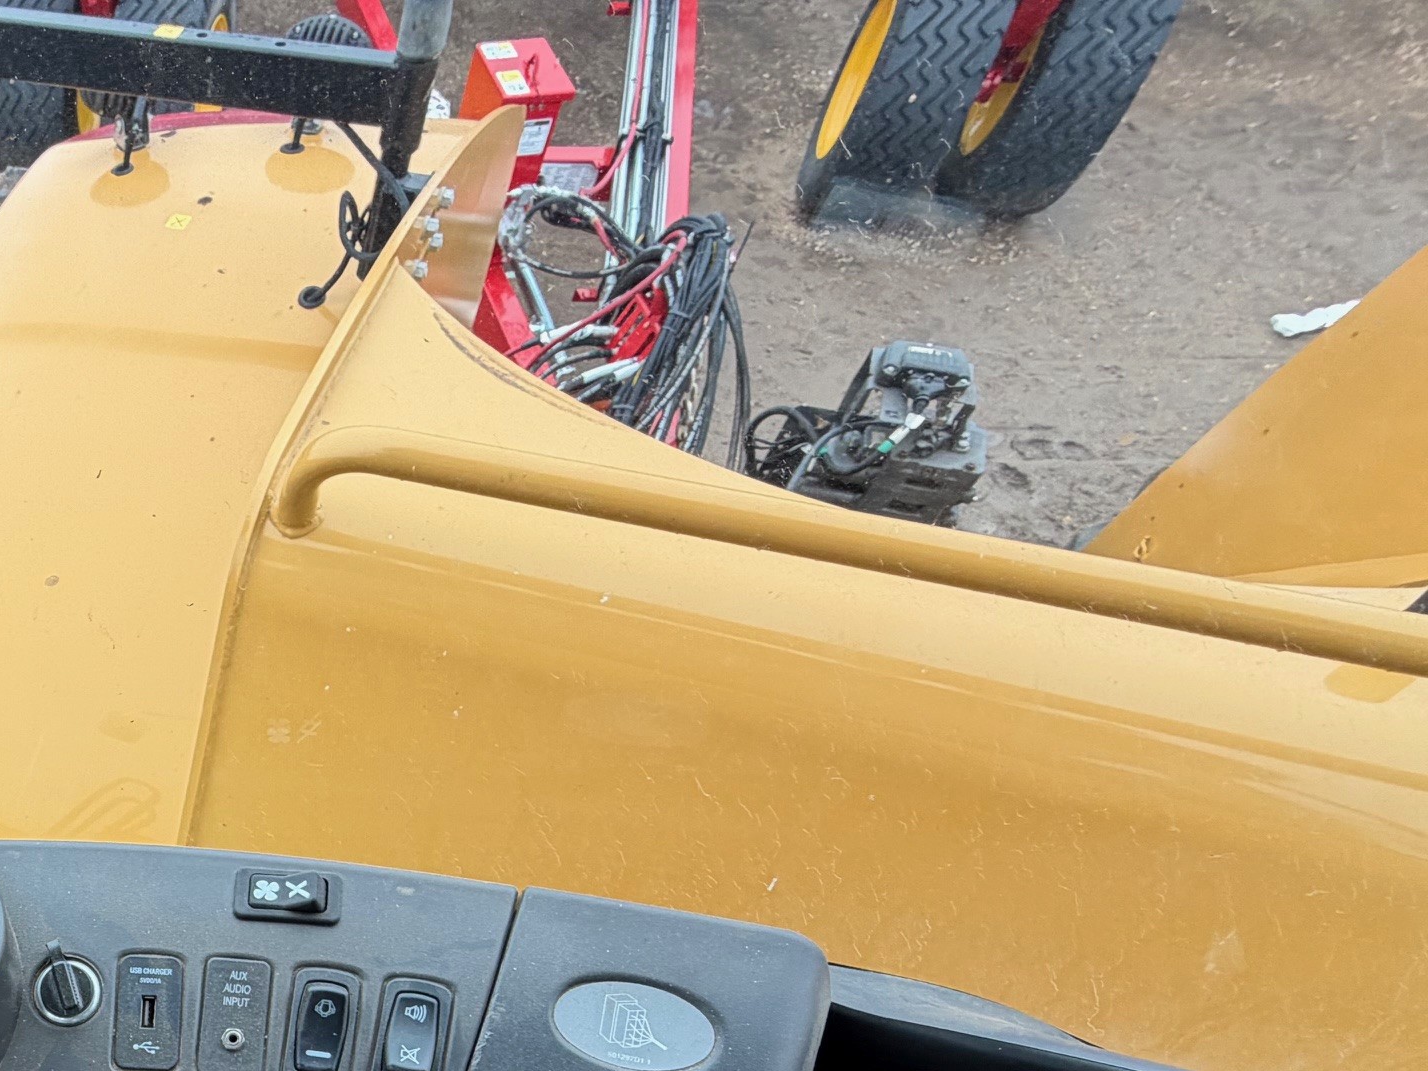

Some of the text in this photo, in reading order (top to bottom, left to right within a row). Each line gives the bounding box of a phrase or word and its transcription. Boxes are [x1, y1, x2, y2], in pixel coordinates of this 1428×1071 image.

[129, 966, 173, 976] USB CHARGER
[229, 970, 248, 981] AUX
[222, 982, 252, 995] AUDIO
[222, 995, 251, 1008] INPUT
